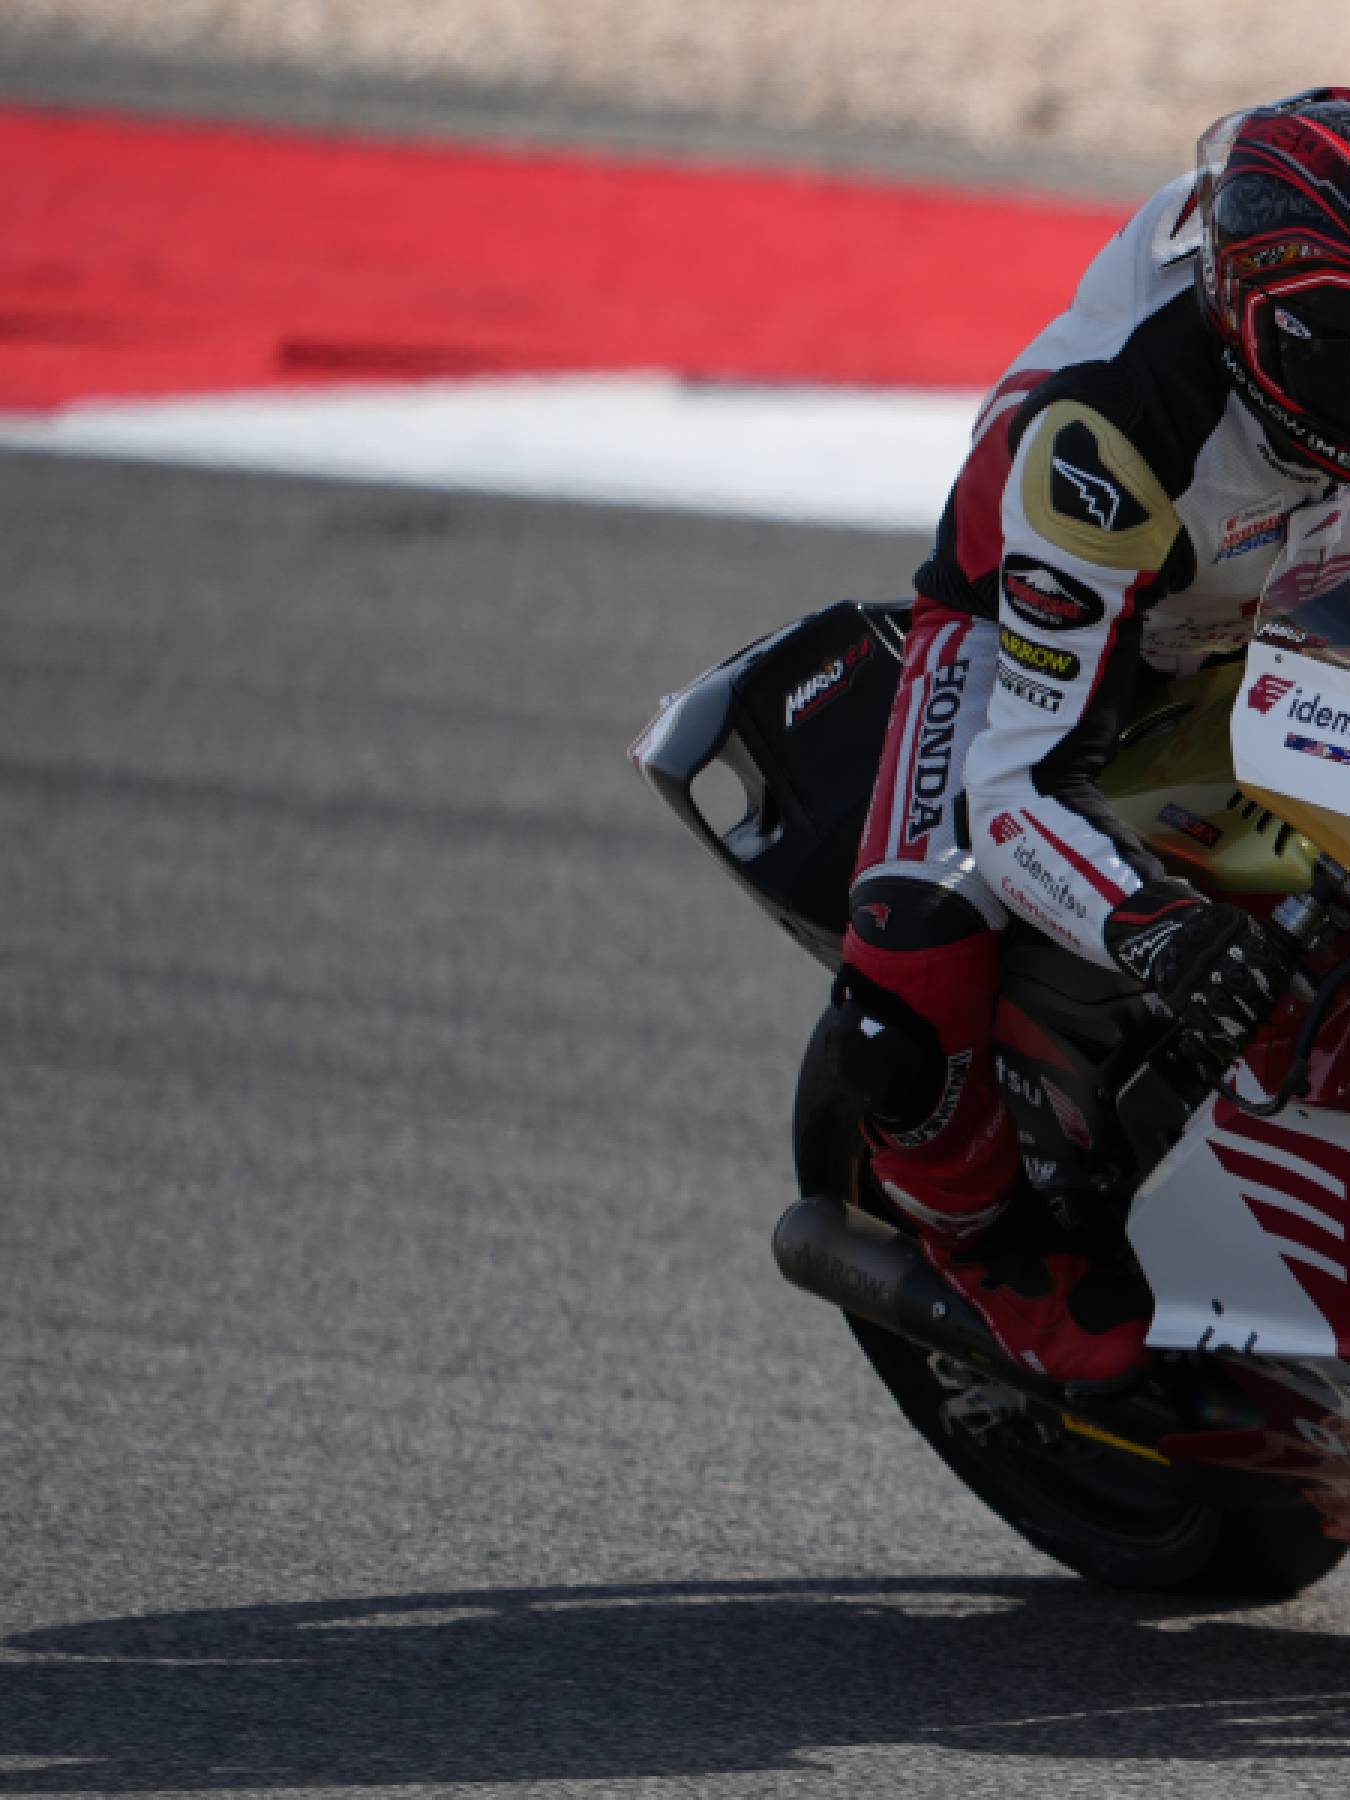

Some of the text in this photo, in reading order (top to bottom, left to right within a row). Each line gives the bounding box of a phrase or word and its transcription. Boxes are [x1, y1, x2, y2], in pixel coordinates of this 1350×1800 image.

[1000, 629, 1074, 673] ARROW
[907, 658, 967, 843] HONDA
[1012, 832, 1088, 920] idemitsu
